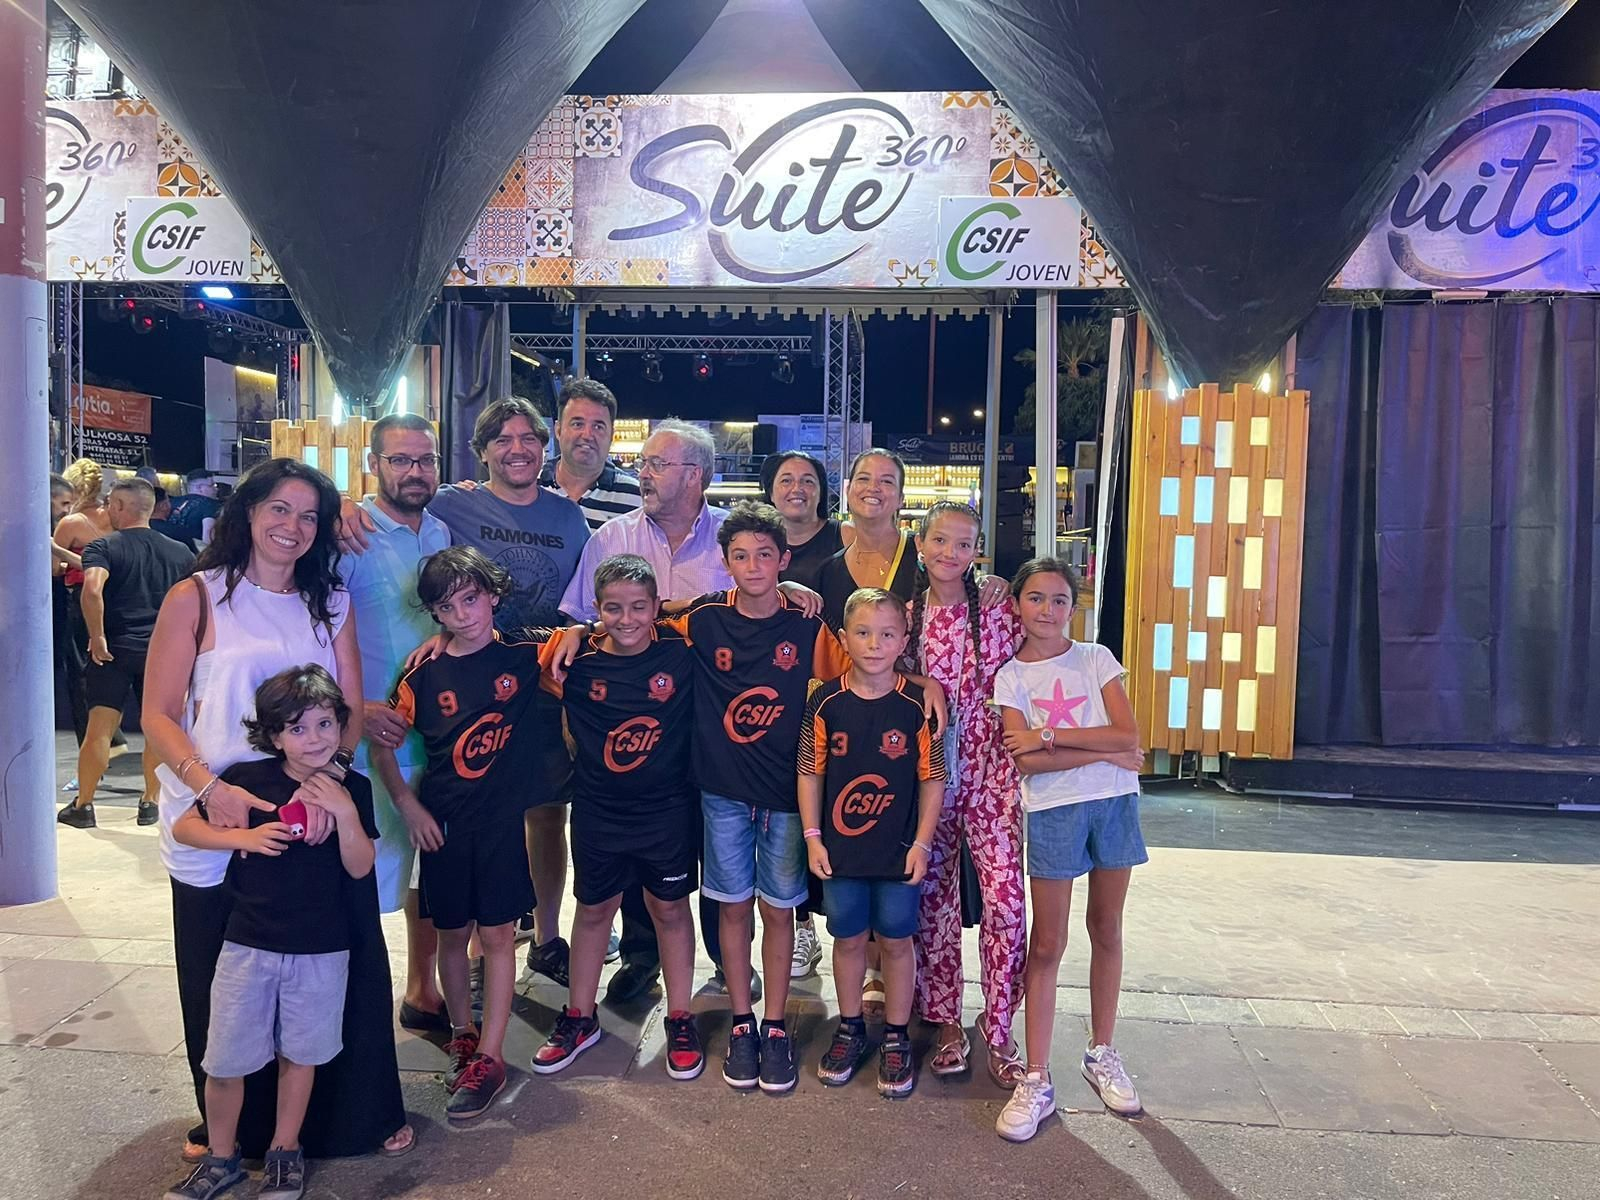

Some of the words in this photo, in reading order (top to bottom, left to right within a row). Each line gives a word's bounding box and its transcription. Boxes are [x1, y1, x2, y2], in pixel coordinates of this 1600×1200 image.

[607, 123, 884, 241] Suite
[1390, 124, 1579, 238] uite
[147, 224, 206, 250] CSIF
[962, 226, 1030, 254] CSIF
[185, 260, 244, 276] JOVEN
[1005, 264, 1071, 281] JOVEN
[134, 435, 148, 444] 52
[480, 525, 564, 549] RAMONES
[714, 647, 733, 672] 8
[588, 679, 607, 701] 5
[438, 690, 459, 717] 9
[734, 704, 785, 726] CSIF
[466, 724, 513, 759] CSIF
[615, 729, 662, 752] CSIF
[831, 731, 849, 756] 3
[844, 792, 895, 815] CSIF
